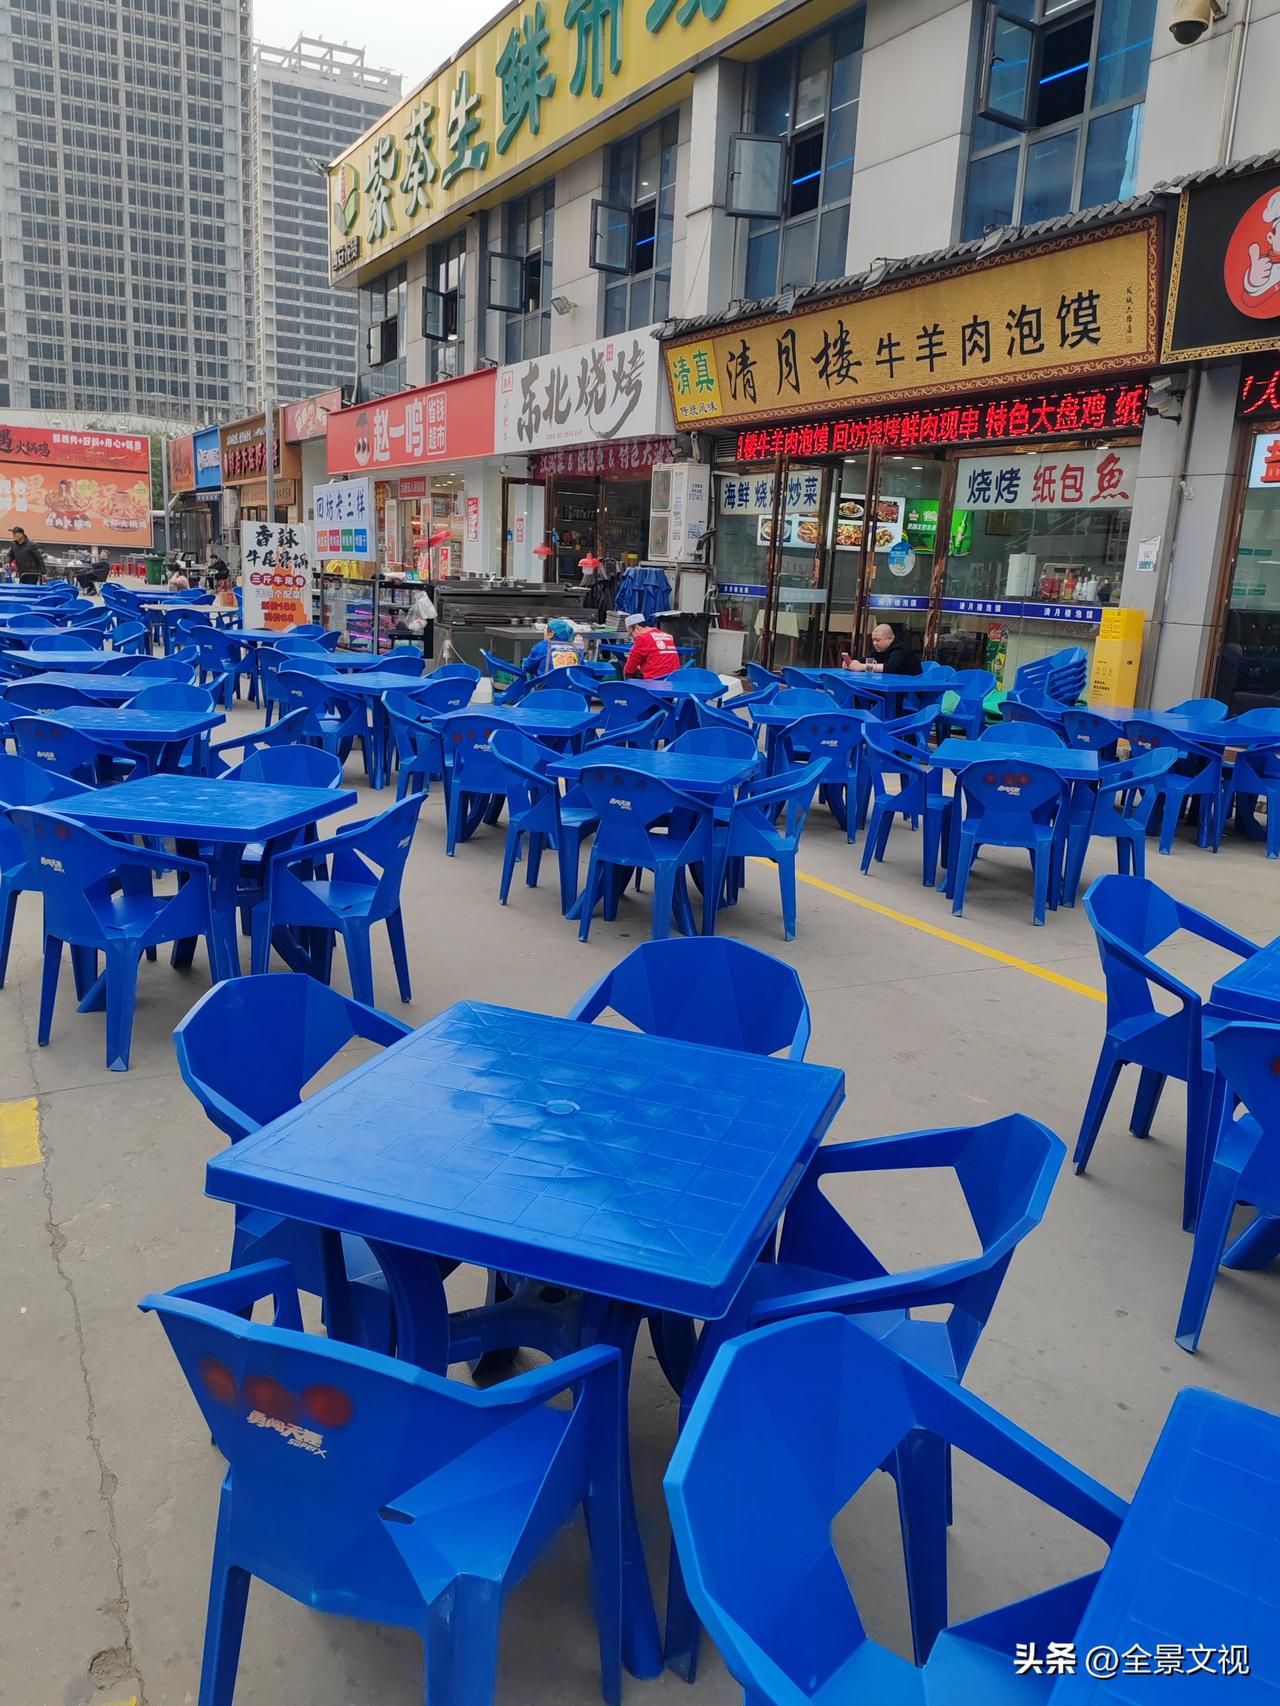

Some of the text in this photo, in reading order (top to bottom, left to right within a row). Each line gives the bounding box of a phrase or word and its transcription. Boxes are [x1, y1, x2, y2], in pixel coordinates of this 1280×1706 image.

[364, 0, 728, 244] 紫葵生鲜市
[725, 289, 1102, 404] 清月楼 牛羊肉泡馍
[517, 338, 645, 445] 东北烧烤
[673, 350, 715, 396] 清真
[680, 401, 718, 417] 传统风味
[986, 395, 1104, 436] 特色大盘鸡
[373, 398, 424, 463] 赵一鸣
[428, 424, 446, 450] 超市
[316, 491, 367, 522] 回坊老三样
[967, 468, 1021, 504] 烧烤
[256, 525, 300, 548] 香辣
